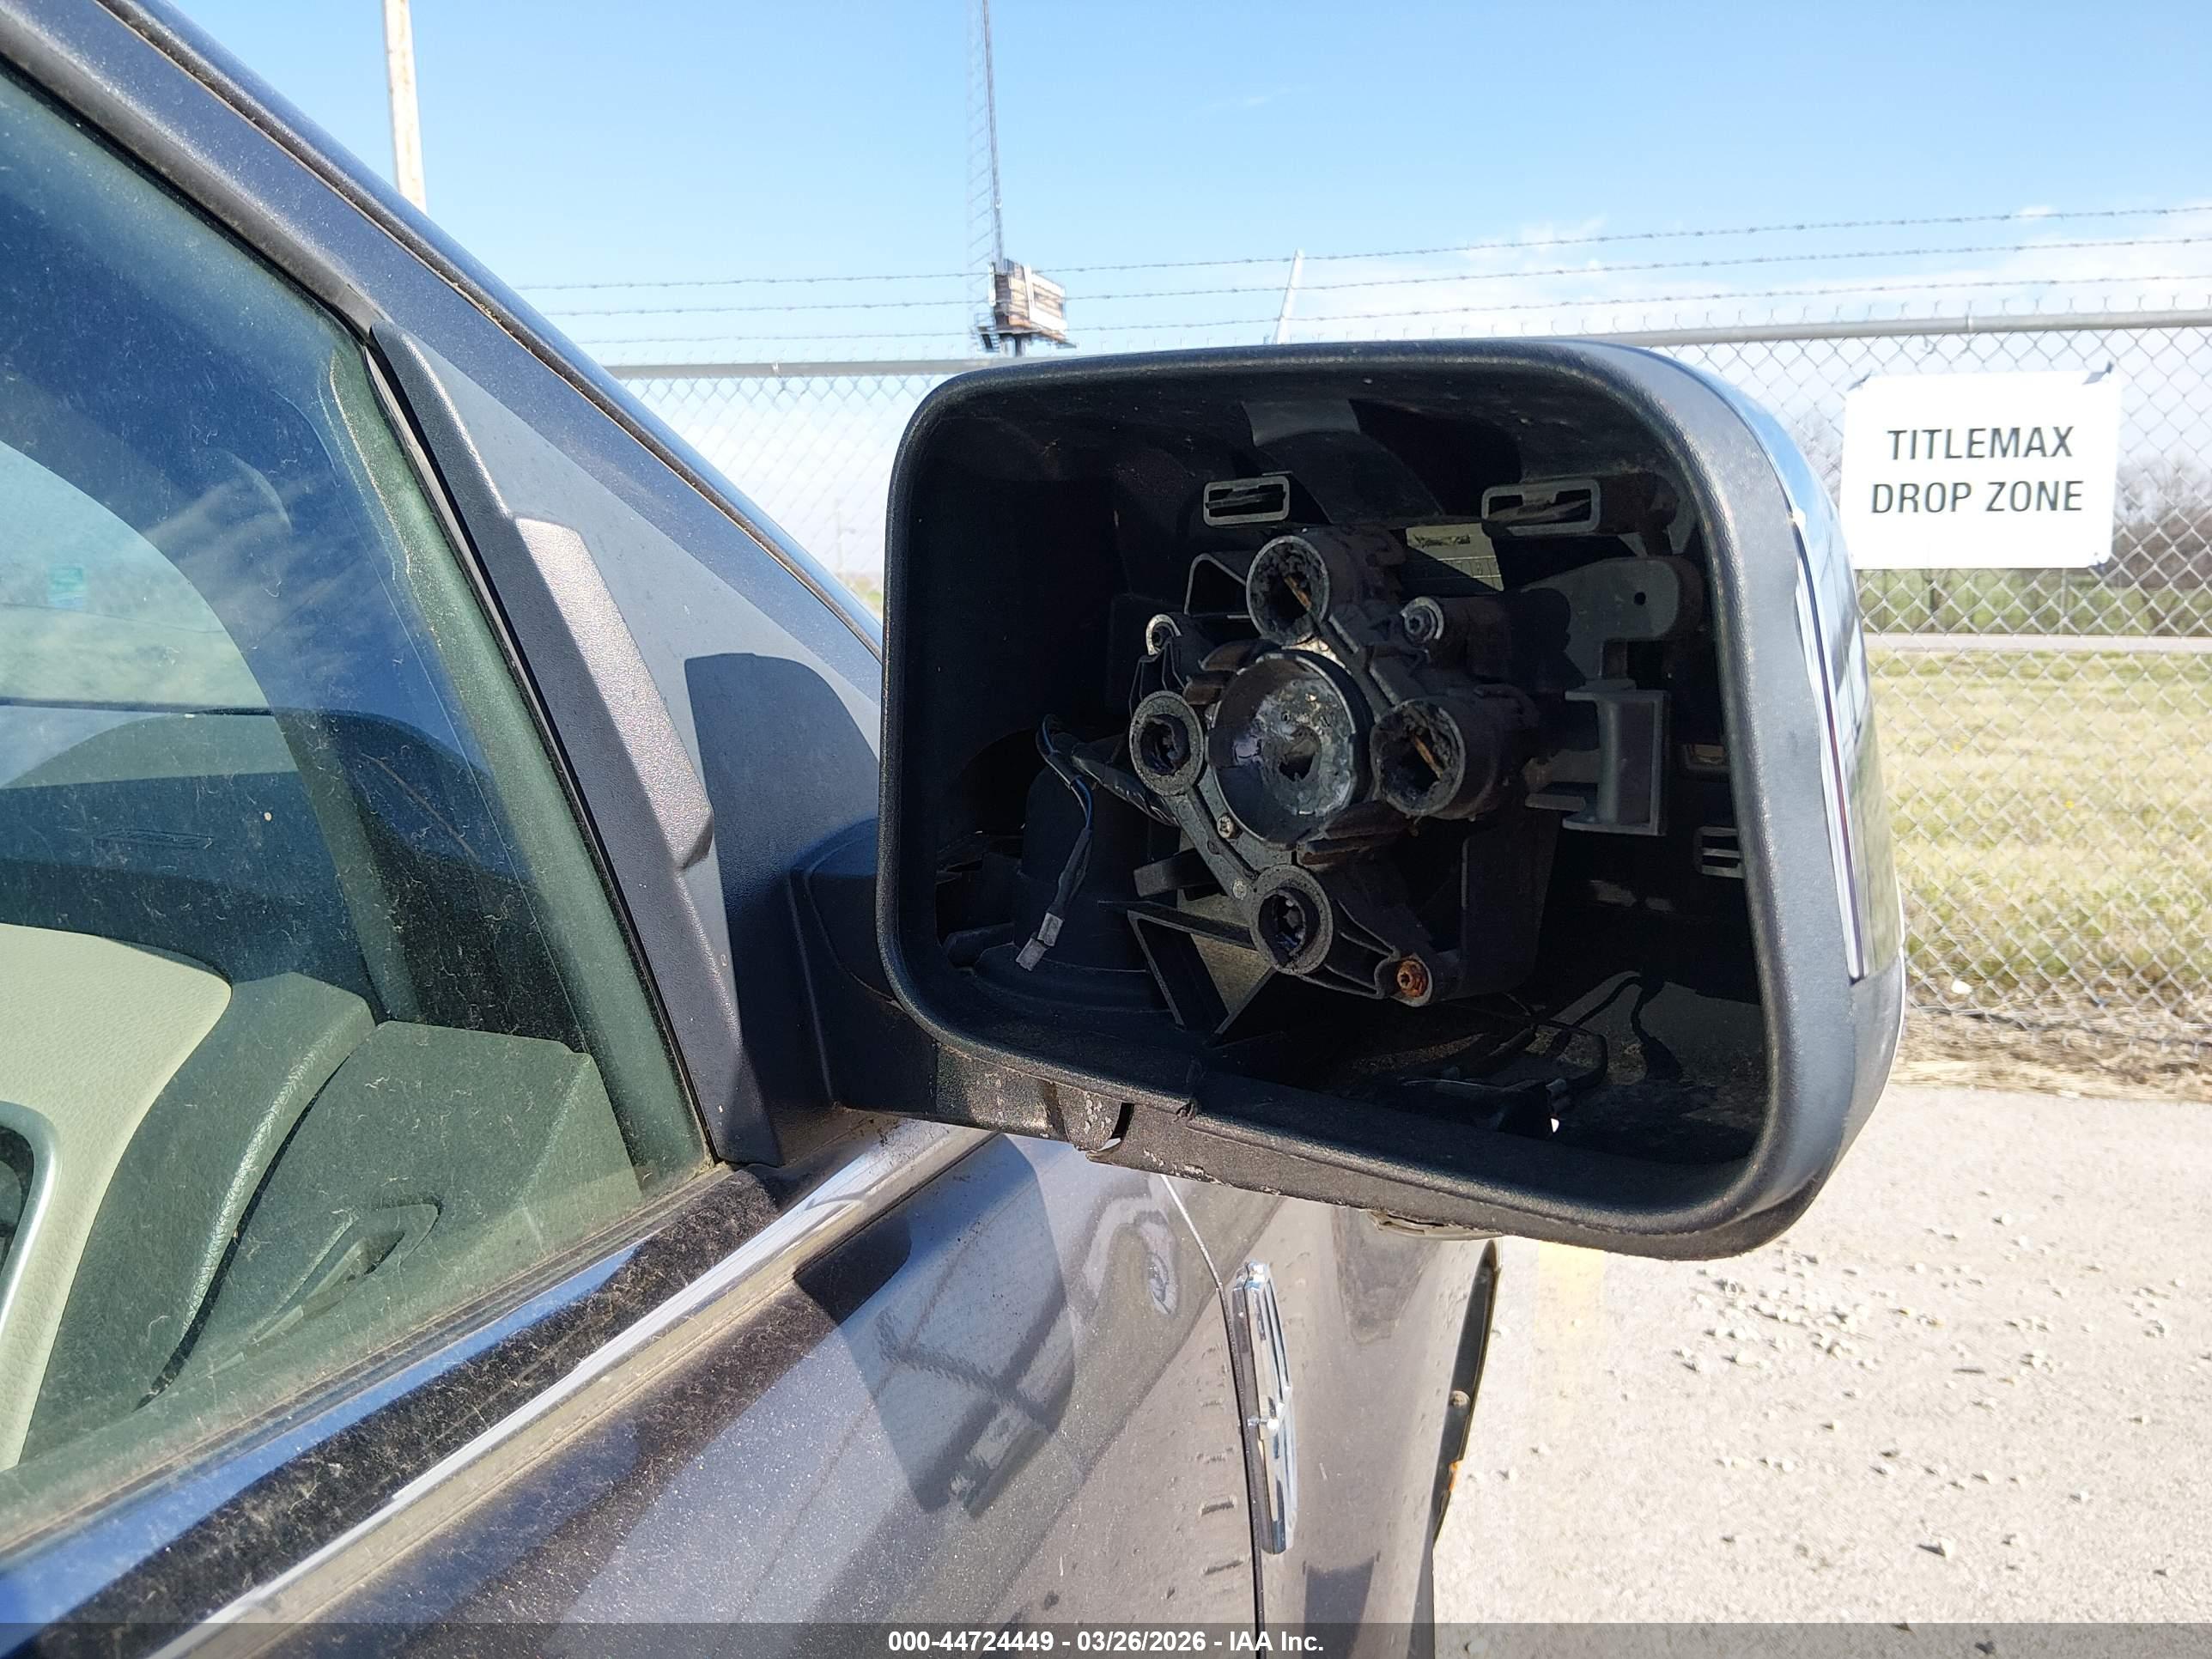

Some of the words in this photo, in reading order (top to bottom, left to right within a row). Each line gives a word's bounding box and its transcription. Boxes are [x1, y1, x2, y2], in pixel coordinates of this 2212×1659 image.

[1887, 426, 2075, 460] TITLEMAX
[1871, 482, 1972, 514] DROP
[1985, 480, 2084, 512] ZONE
